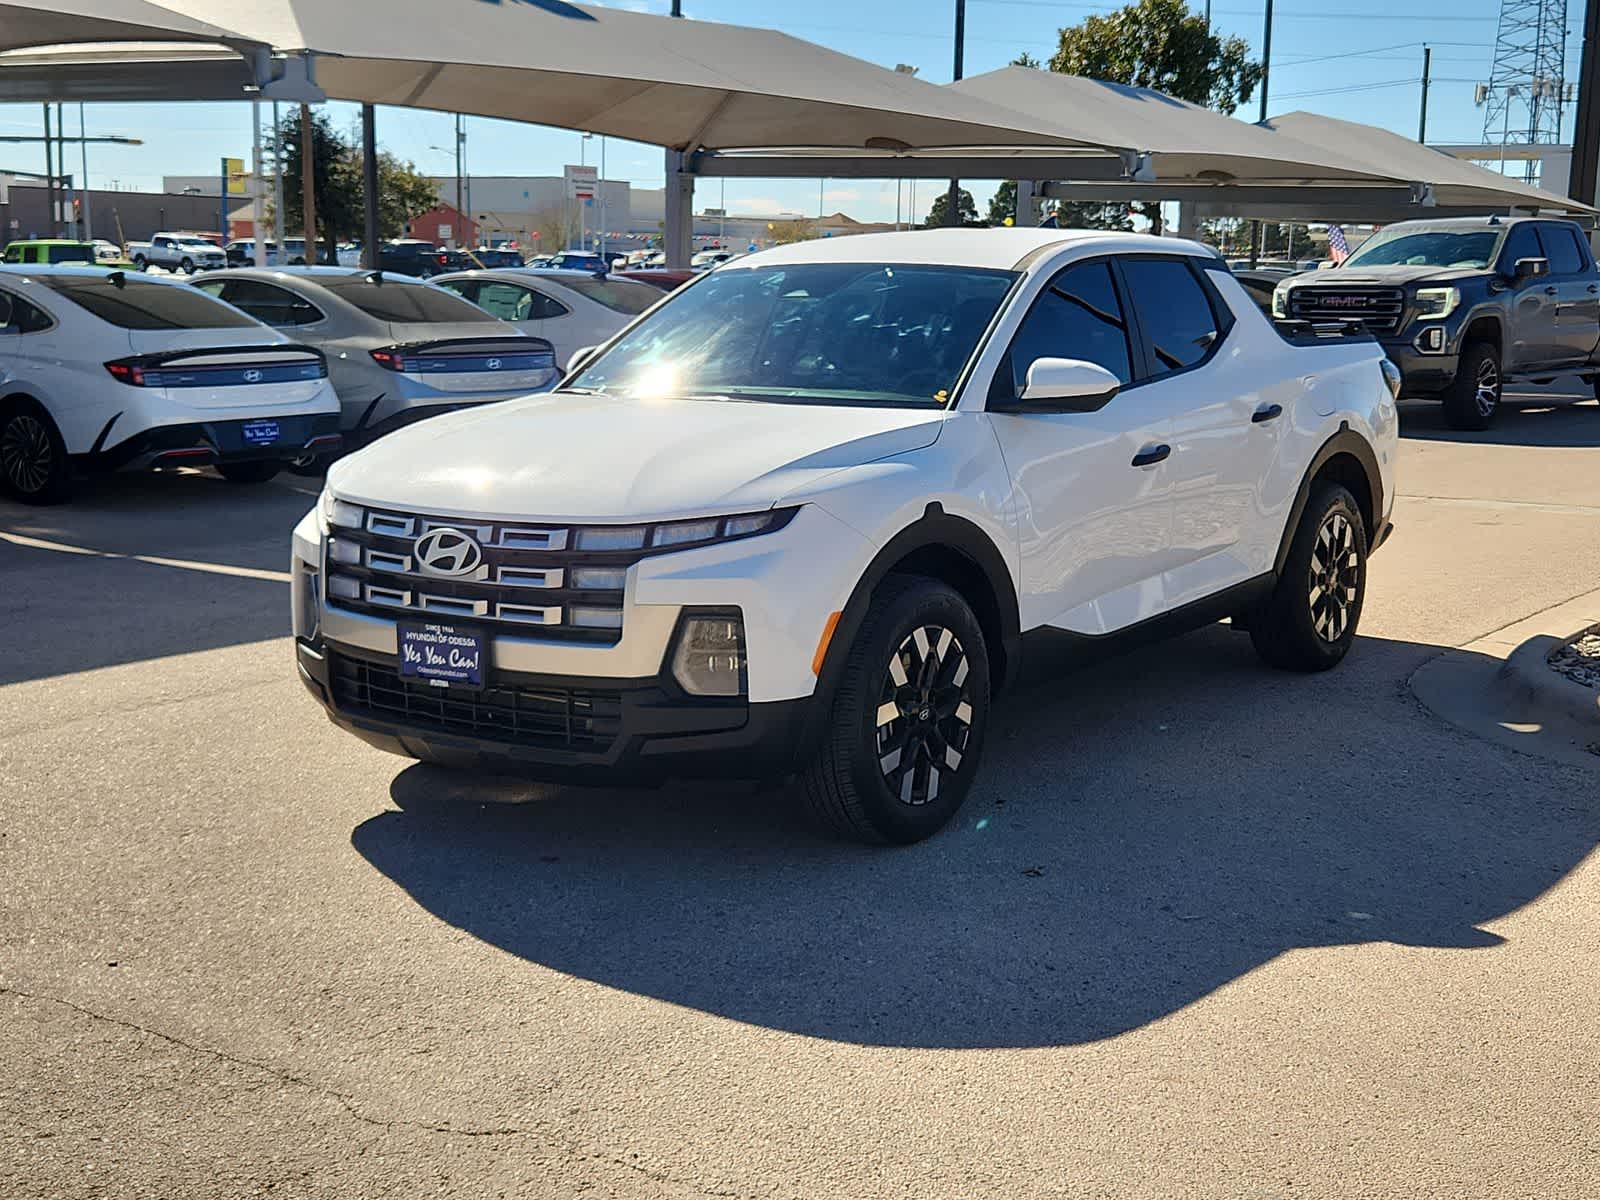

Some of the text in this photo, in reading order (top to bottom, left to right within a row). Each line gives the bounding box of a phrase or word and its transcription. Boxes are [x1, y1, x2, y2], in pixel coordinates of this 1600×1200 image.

[406, 632, 476, 647] HYUNDAI OF ODESSA
[403, 643, 479, 670] Yes You Can!
